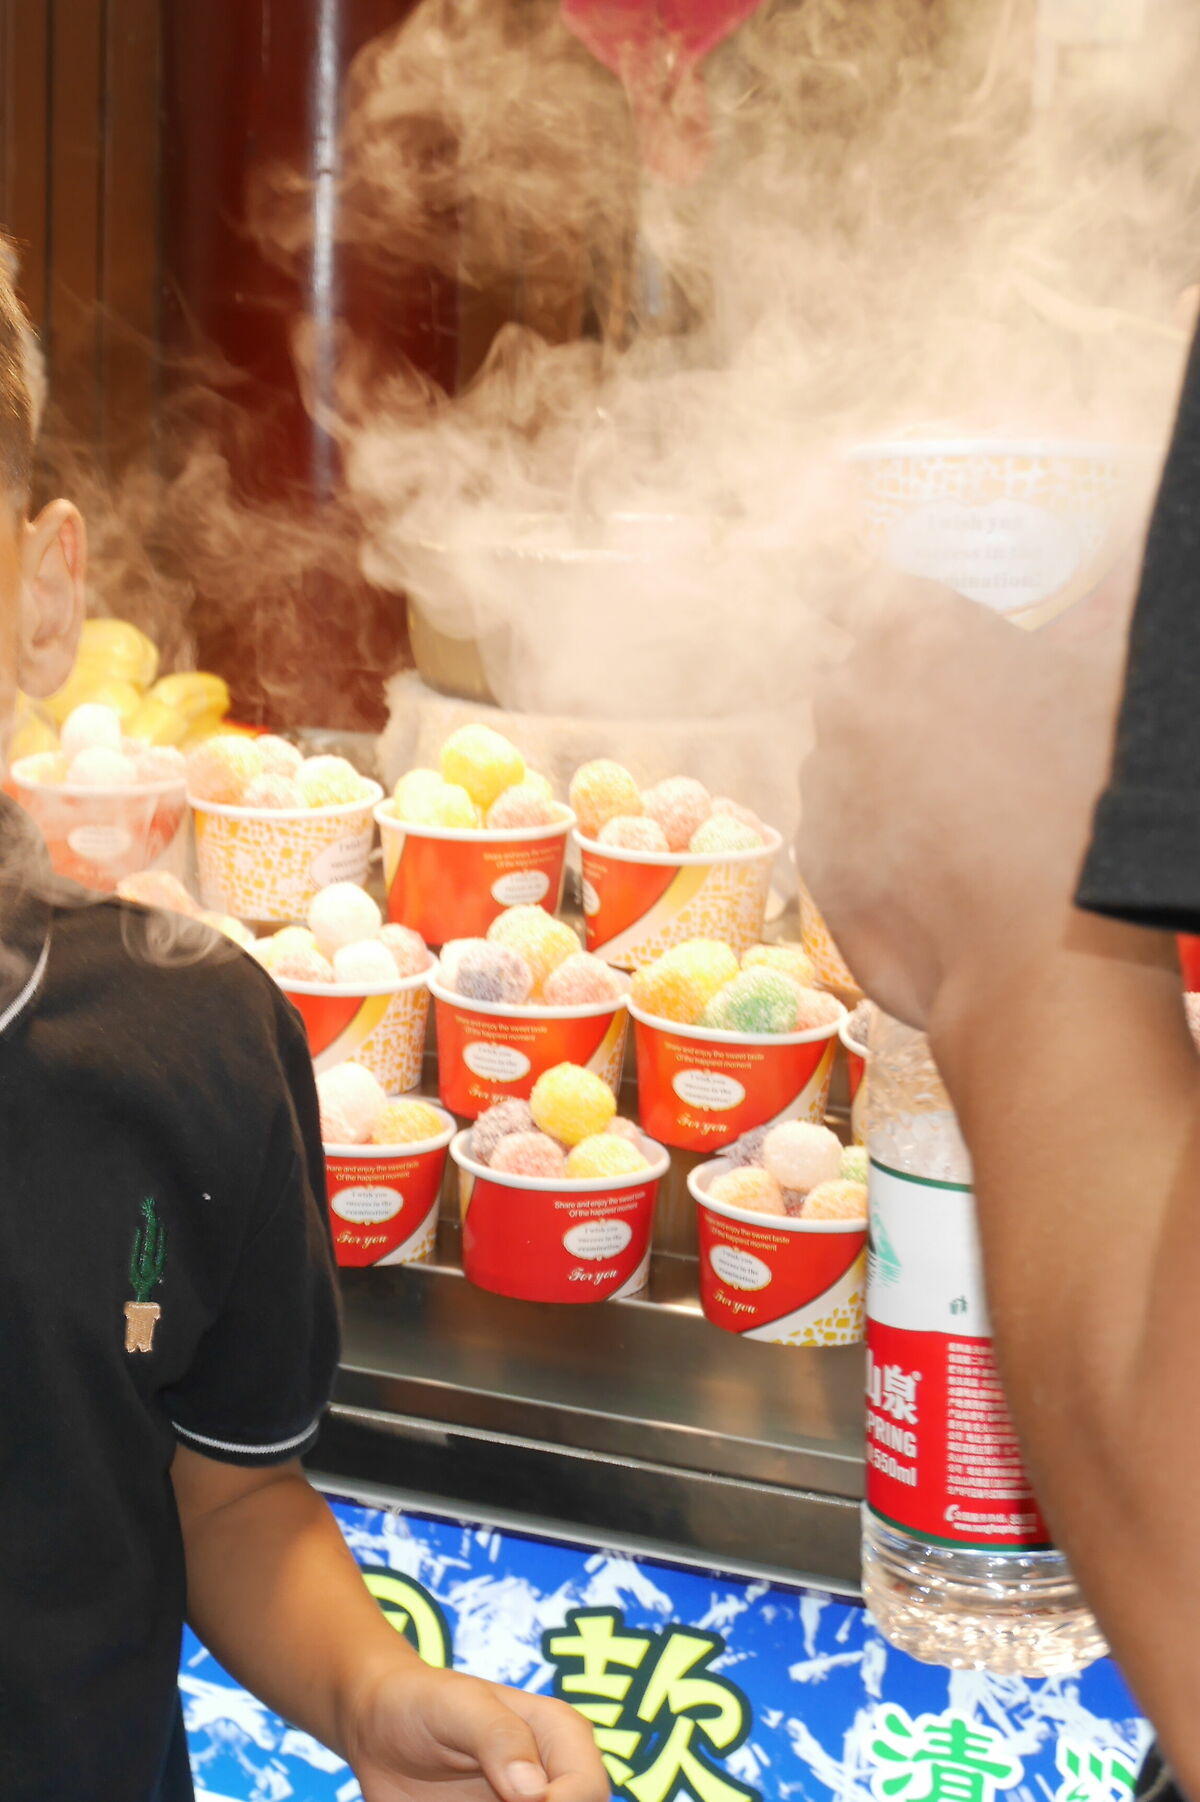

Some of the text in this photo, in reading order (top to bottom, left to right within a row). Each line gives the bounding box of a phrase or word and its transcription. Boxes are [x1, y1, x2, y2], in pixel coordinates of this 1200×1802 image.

[677, 1112, 727, 1136] For you
[554, 1201, 576, 1209] Share
[577, 1200, 590, 1208] and
[590, 1199, 608, 1208] enjoy
[337, 1231, 388, 1249] For you
[568, 1267, 618, 1285] For you
[715, 1289, 756, 1314] For you
